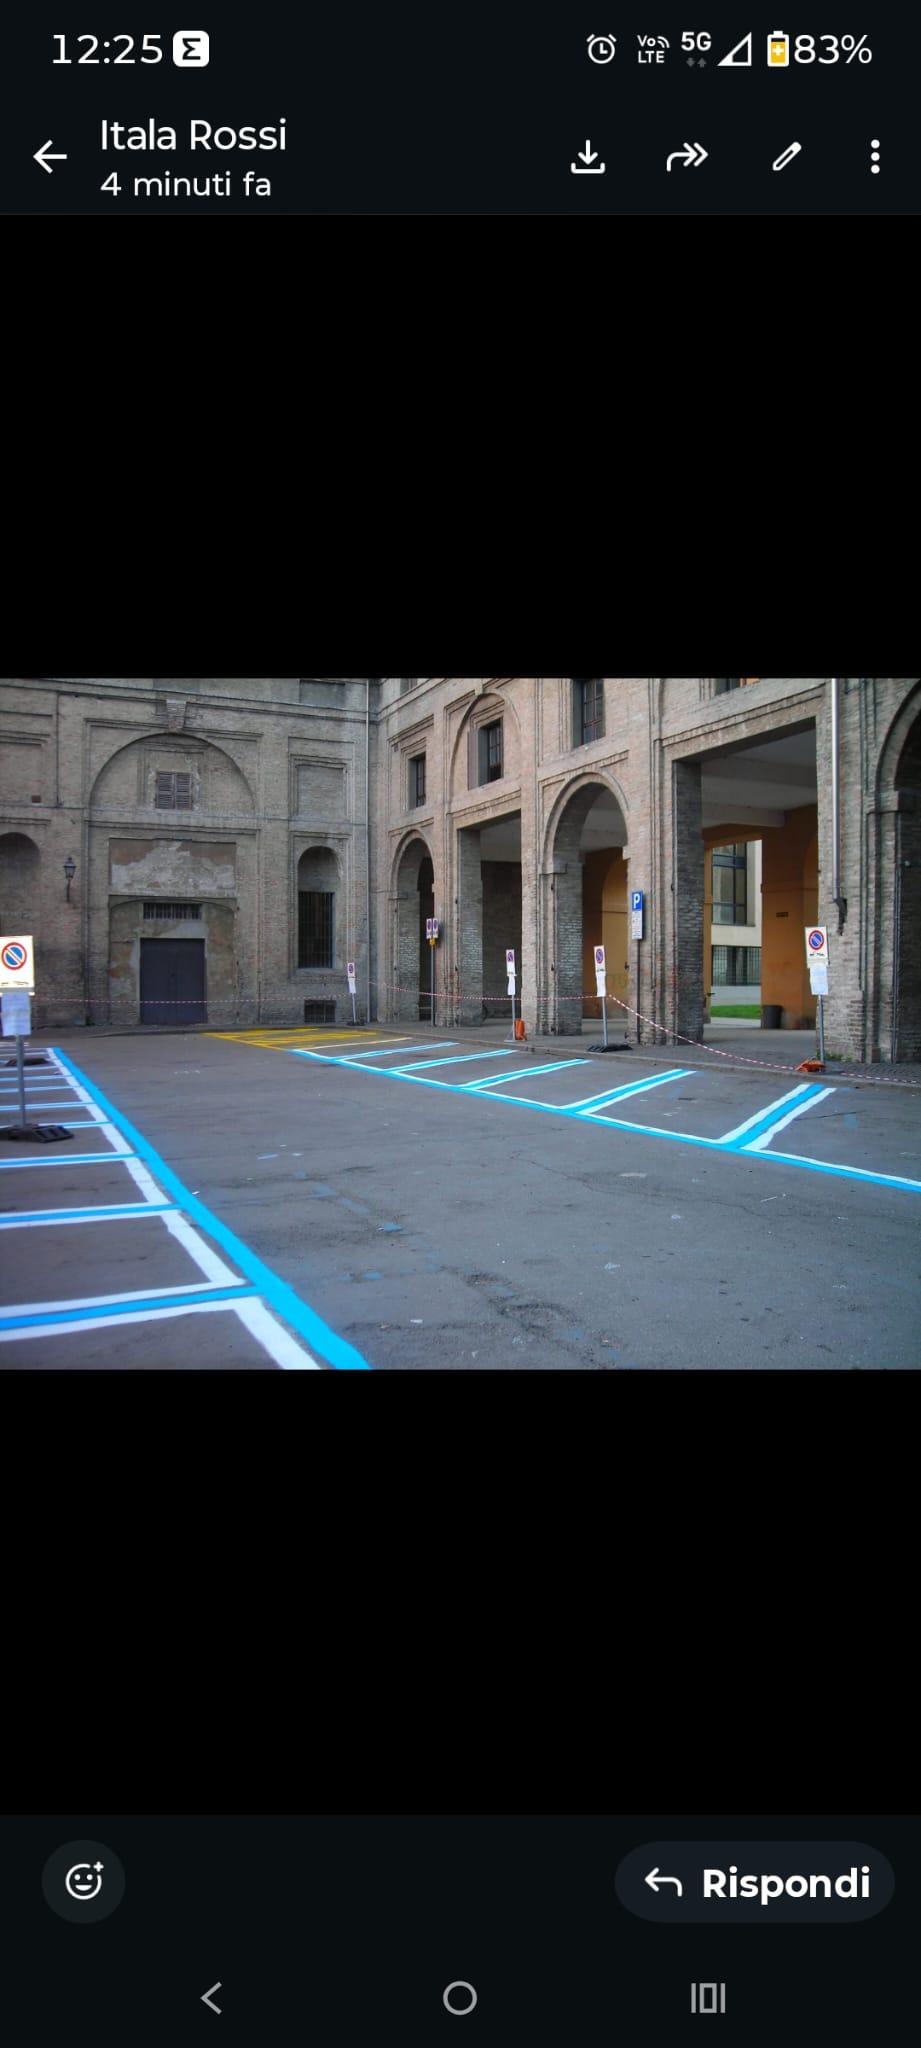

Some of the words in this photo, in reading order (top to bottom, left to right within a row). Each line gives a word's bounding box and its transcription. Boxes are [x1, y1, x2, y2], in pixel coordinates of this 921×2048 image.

[53, 35, 162, 63] 12:25
[681, 31, 712, 52] 5G
[794, 35, 873, 64] 83%
[637, 50, 664, 64] LTE
[101, 118, 176, 151] Itala
[190, 118, 287, 151] Rossi
[100, 171, 121, 197] 4
[134, 171, 231, 197] minuti
[243, 171, 271, 197] fa
[632, 893, 641, 909] P
[703, 1866, 870, 1906] Rispondi
